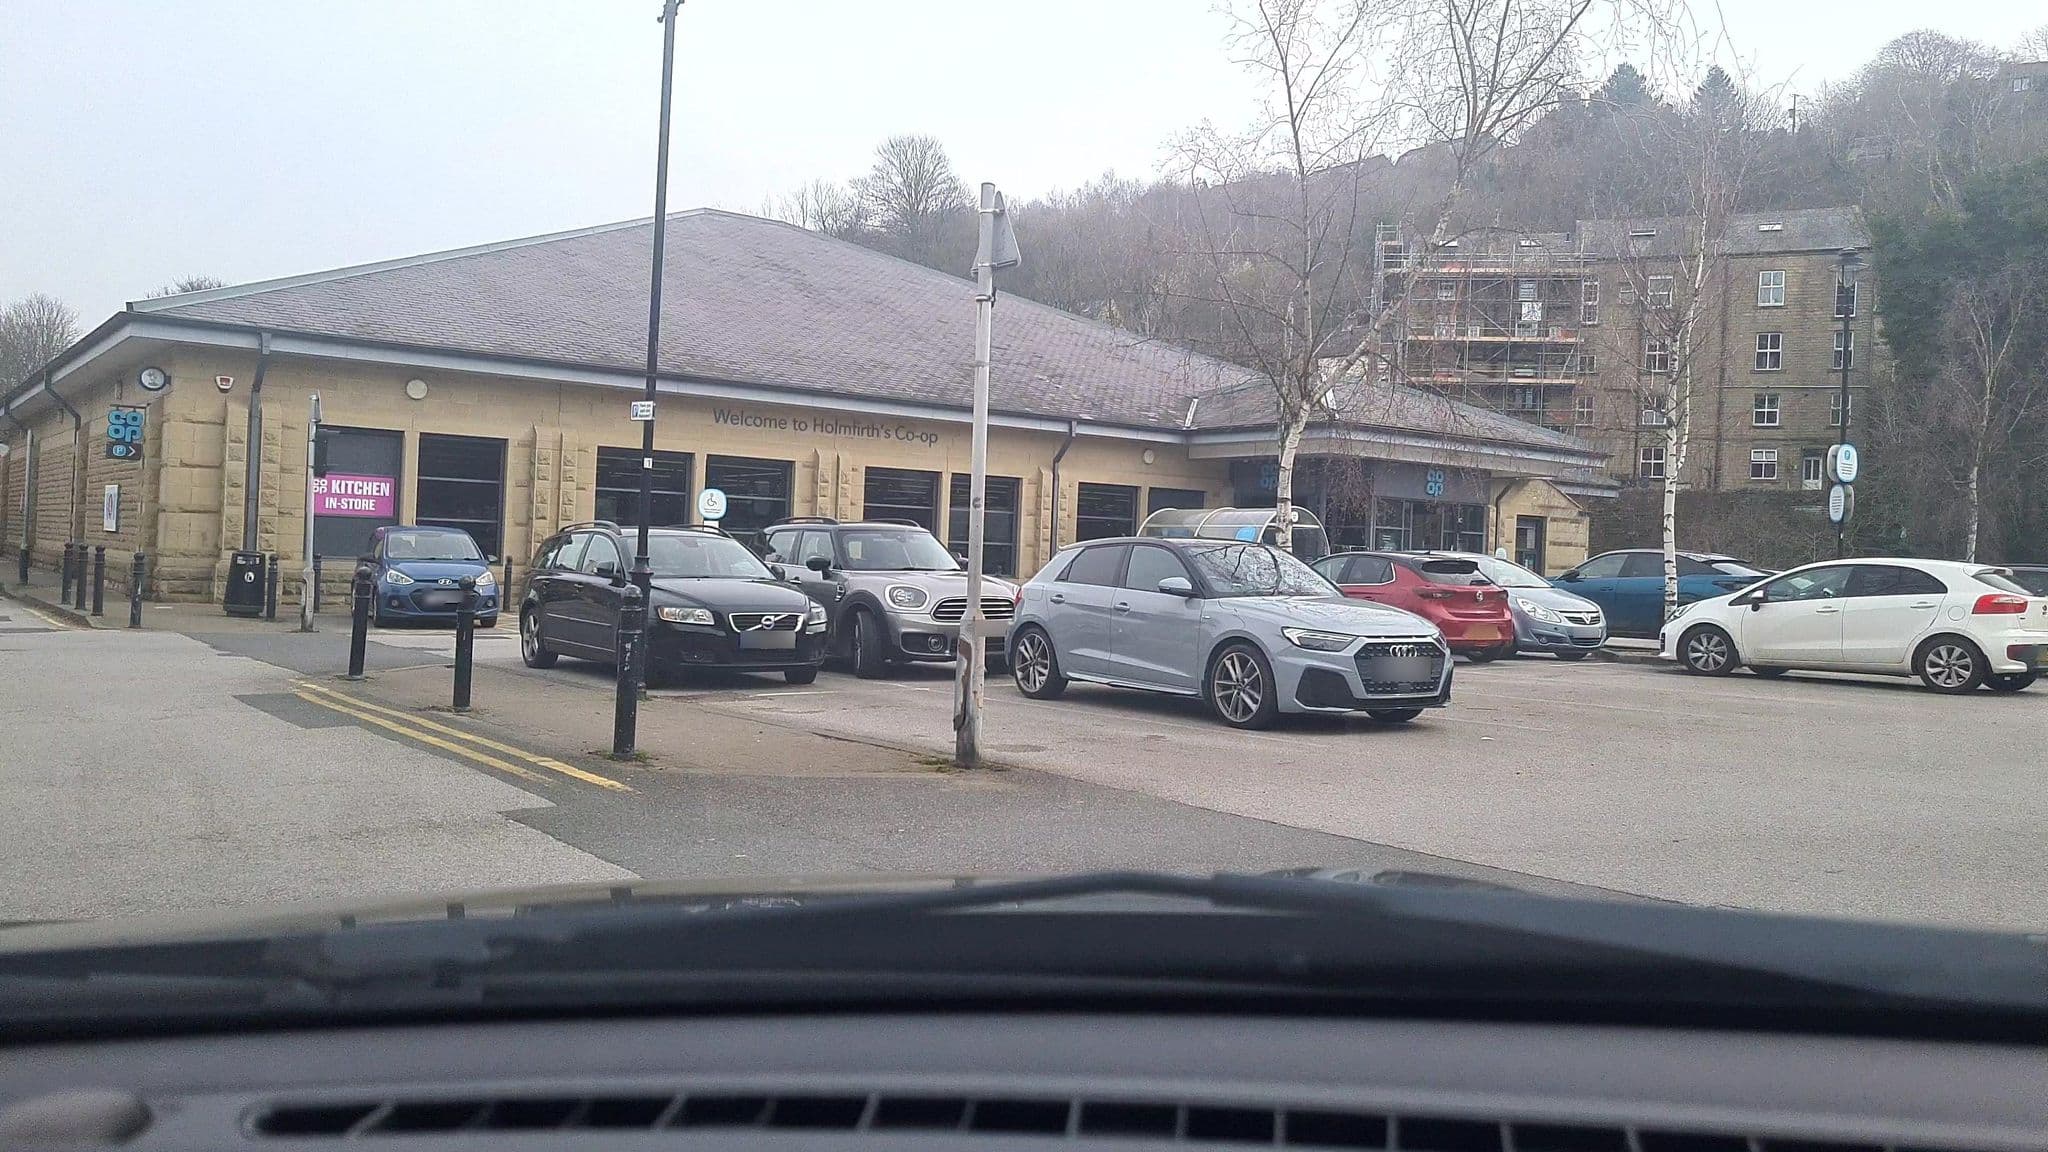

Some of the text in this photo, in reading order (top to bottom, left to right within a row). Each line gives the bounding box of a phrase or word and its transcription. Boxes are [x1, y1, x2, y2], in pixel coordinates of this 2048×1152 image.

[713, 407, 939, 448] Welcome to Holmfirth's Co-op
[331, 479, 390, 497] KITCHEN
[325, 497, 376, 511] IN-STORE
